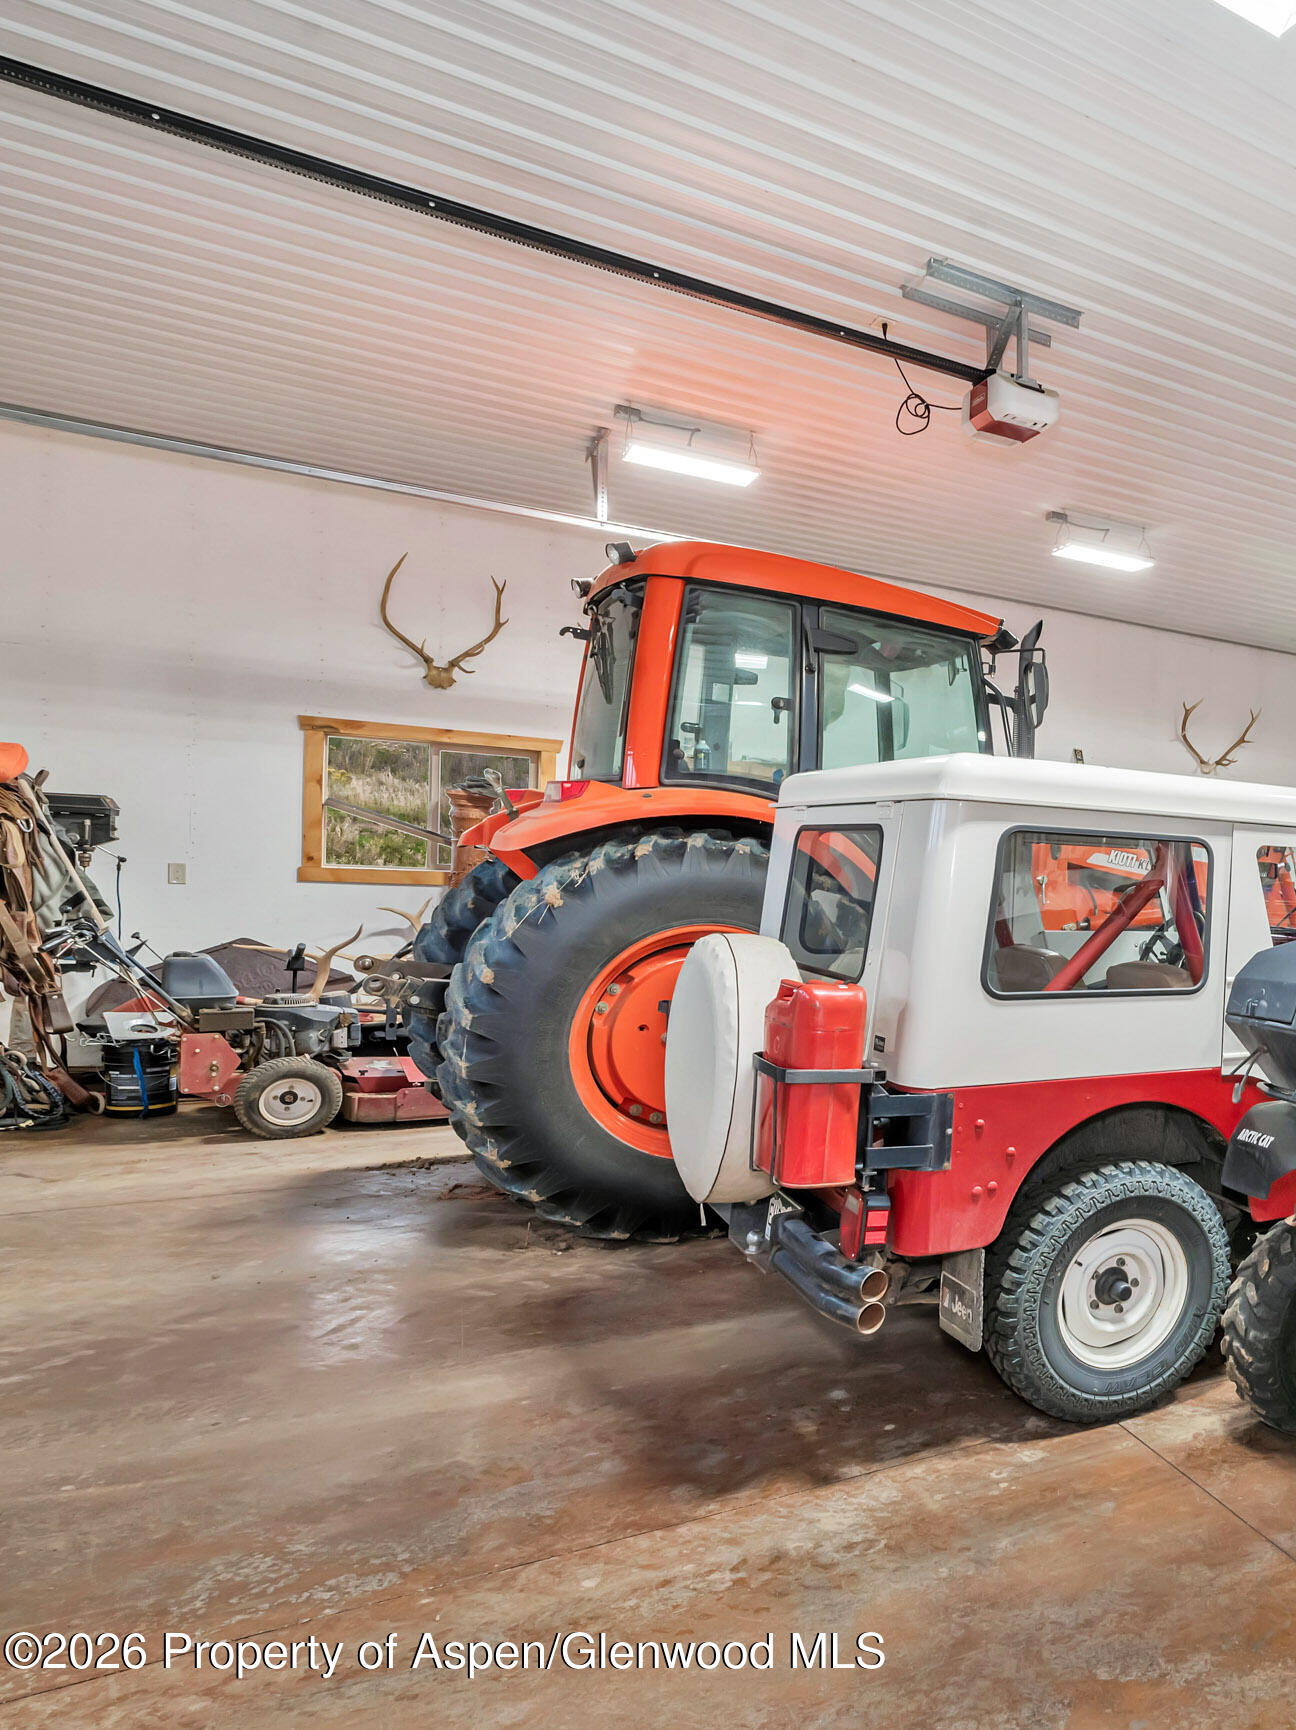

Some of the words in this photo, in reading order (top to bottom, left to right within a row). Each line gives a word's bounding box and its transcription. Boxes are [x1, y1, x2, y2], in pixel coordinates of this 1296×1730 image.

[1108, 849, 1138, 868] KIOTI
[1236, 1128, 1263, 1145] ARCTIC
[1258, 1132, 1276, 1149] CAT
